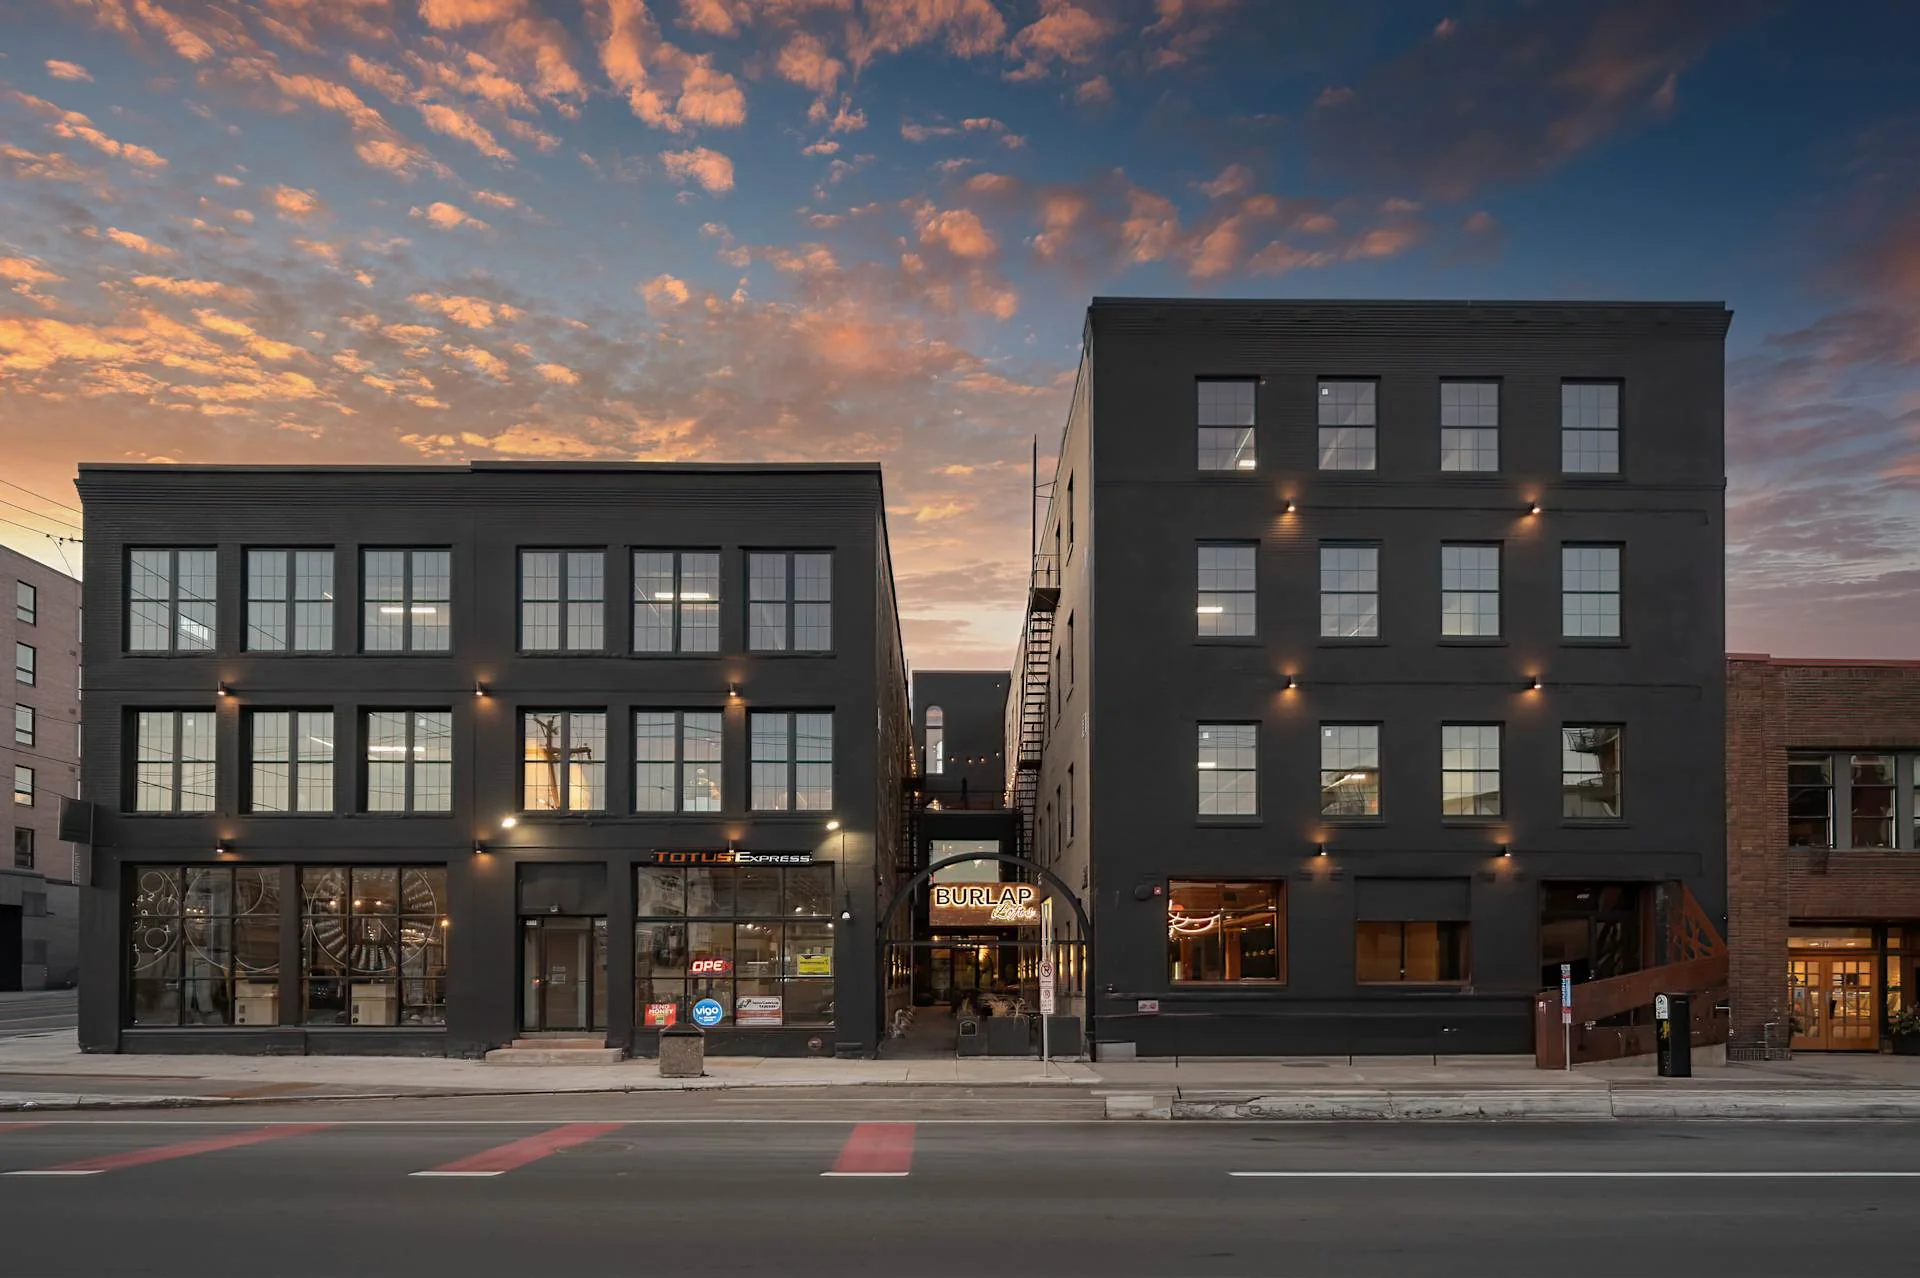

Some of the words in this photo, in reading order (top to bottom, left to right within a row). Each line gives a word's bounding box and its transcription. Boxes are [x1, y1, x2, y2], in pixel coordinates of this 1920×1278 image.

[936, 887, 1032, 905] BURLAP
[991, 902, 1037, 920] Lofts
[695, 1005, 719, 1016] vigo
